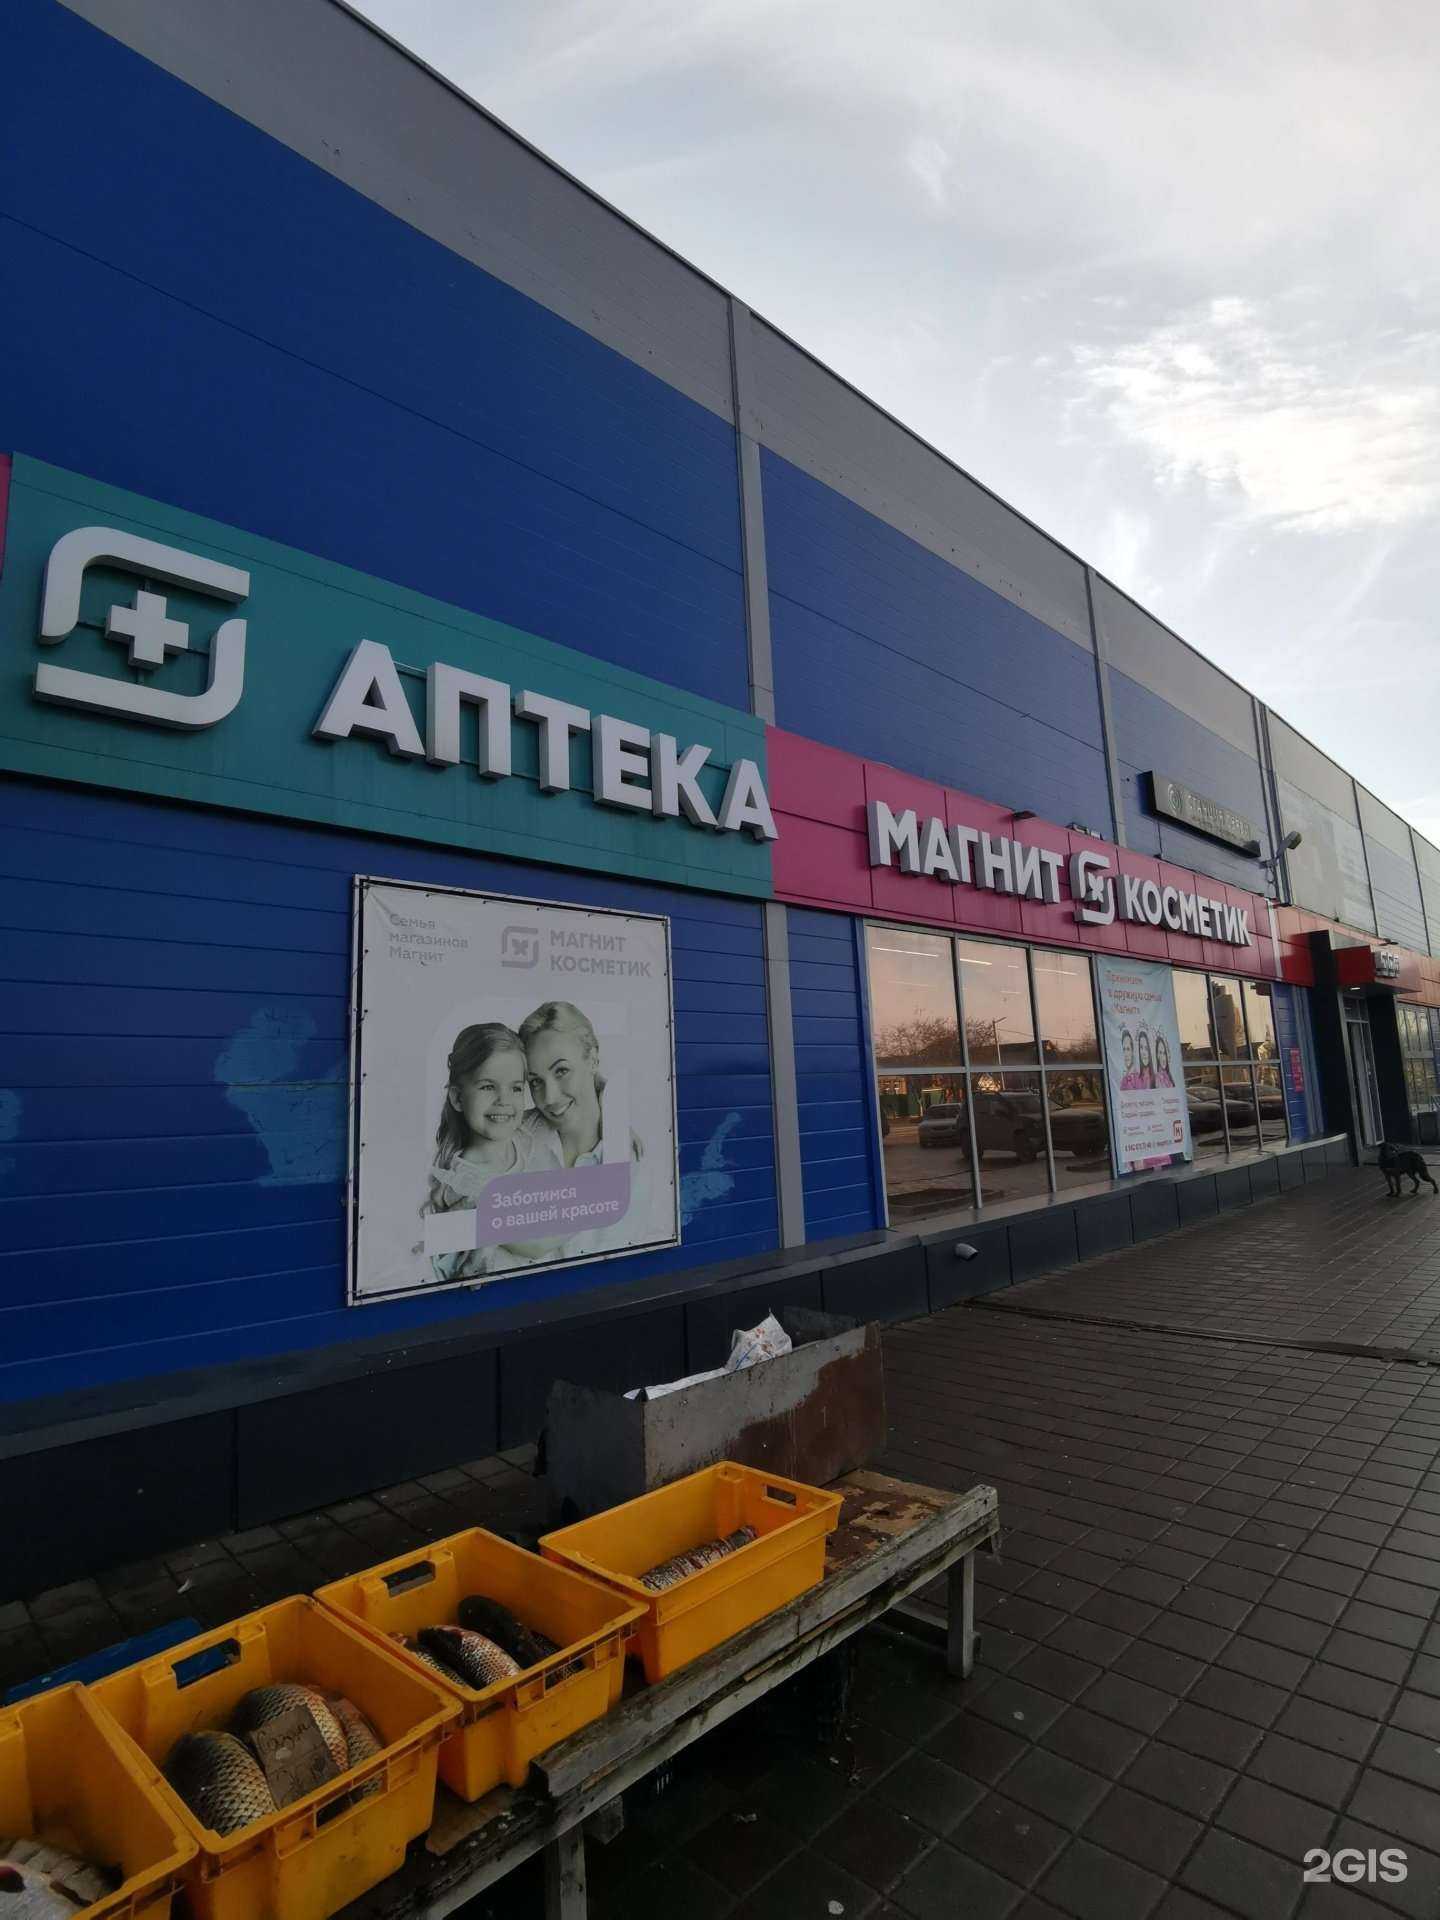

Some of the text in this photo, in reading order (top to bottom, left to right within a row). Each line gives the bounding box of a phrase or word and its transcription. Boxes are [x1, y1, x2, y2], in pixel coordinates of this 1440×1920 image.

[312, 638, 779, 841] АПТЕКА
[867, 800, 1252, 947] МАГНИТ КОСМЕТИК
[389, 913, 436, 930] Семья
[389, 933, 469, 949] магазинов
[550, 930, 627, 953] МАГНИТ
[389, 945, 445, 962] Магнит
[550, 954, 652, 977] КОСМЕТИК
[491, 1187, 577, 1209] Заботимся
[491, 1200, 620, 1230] о вашей красоте
